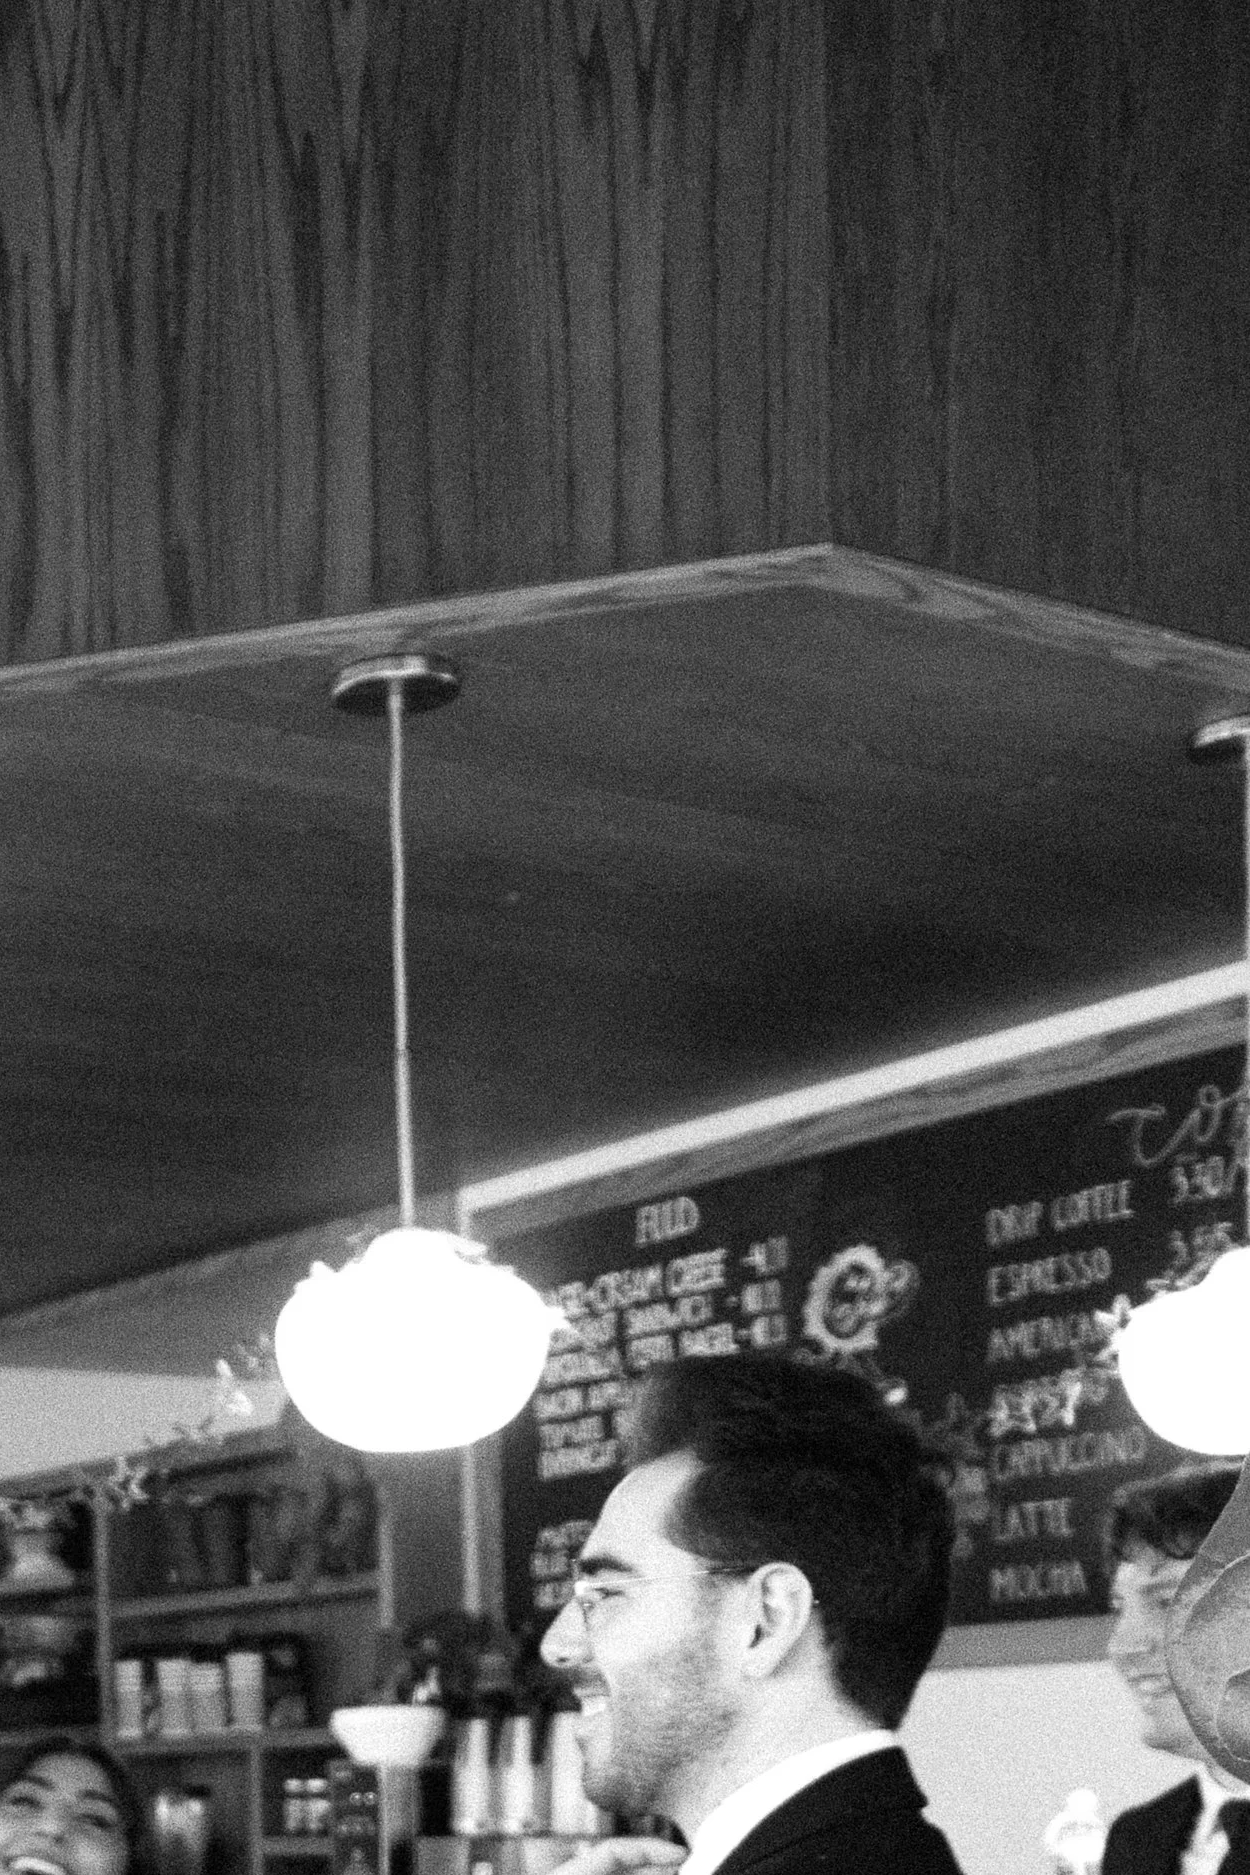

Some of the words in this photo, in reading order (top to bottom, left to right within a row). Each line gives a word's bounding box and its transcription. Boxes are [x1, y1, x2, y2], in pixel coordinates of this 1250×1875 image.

[984, 1201, 1045, 1247] DRIP
[1051, 1179, 1135, 1233] COFFEE
[987, 1247, 1112, 1305] ESPRESSO
[986, 1310, 1112, 1363] AMERICA
[991, 1424, 1147, 1484] CAPPUCCINO
[992, 1497, 1074, 1544] LATTE
[988, 1559, 1089, 1602] MOCHA
